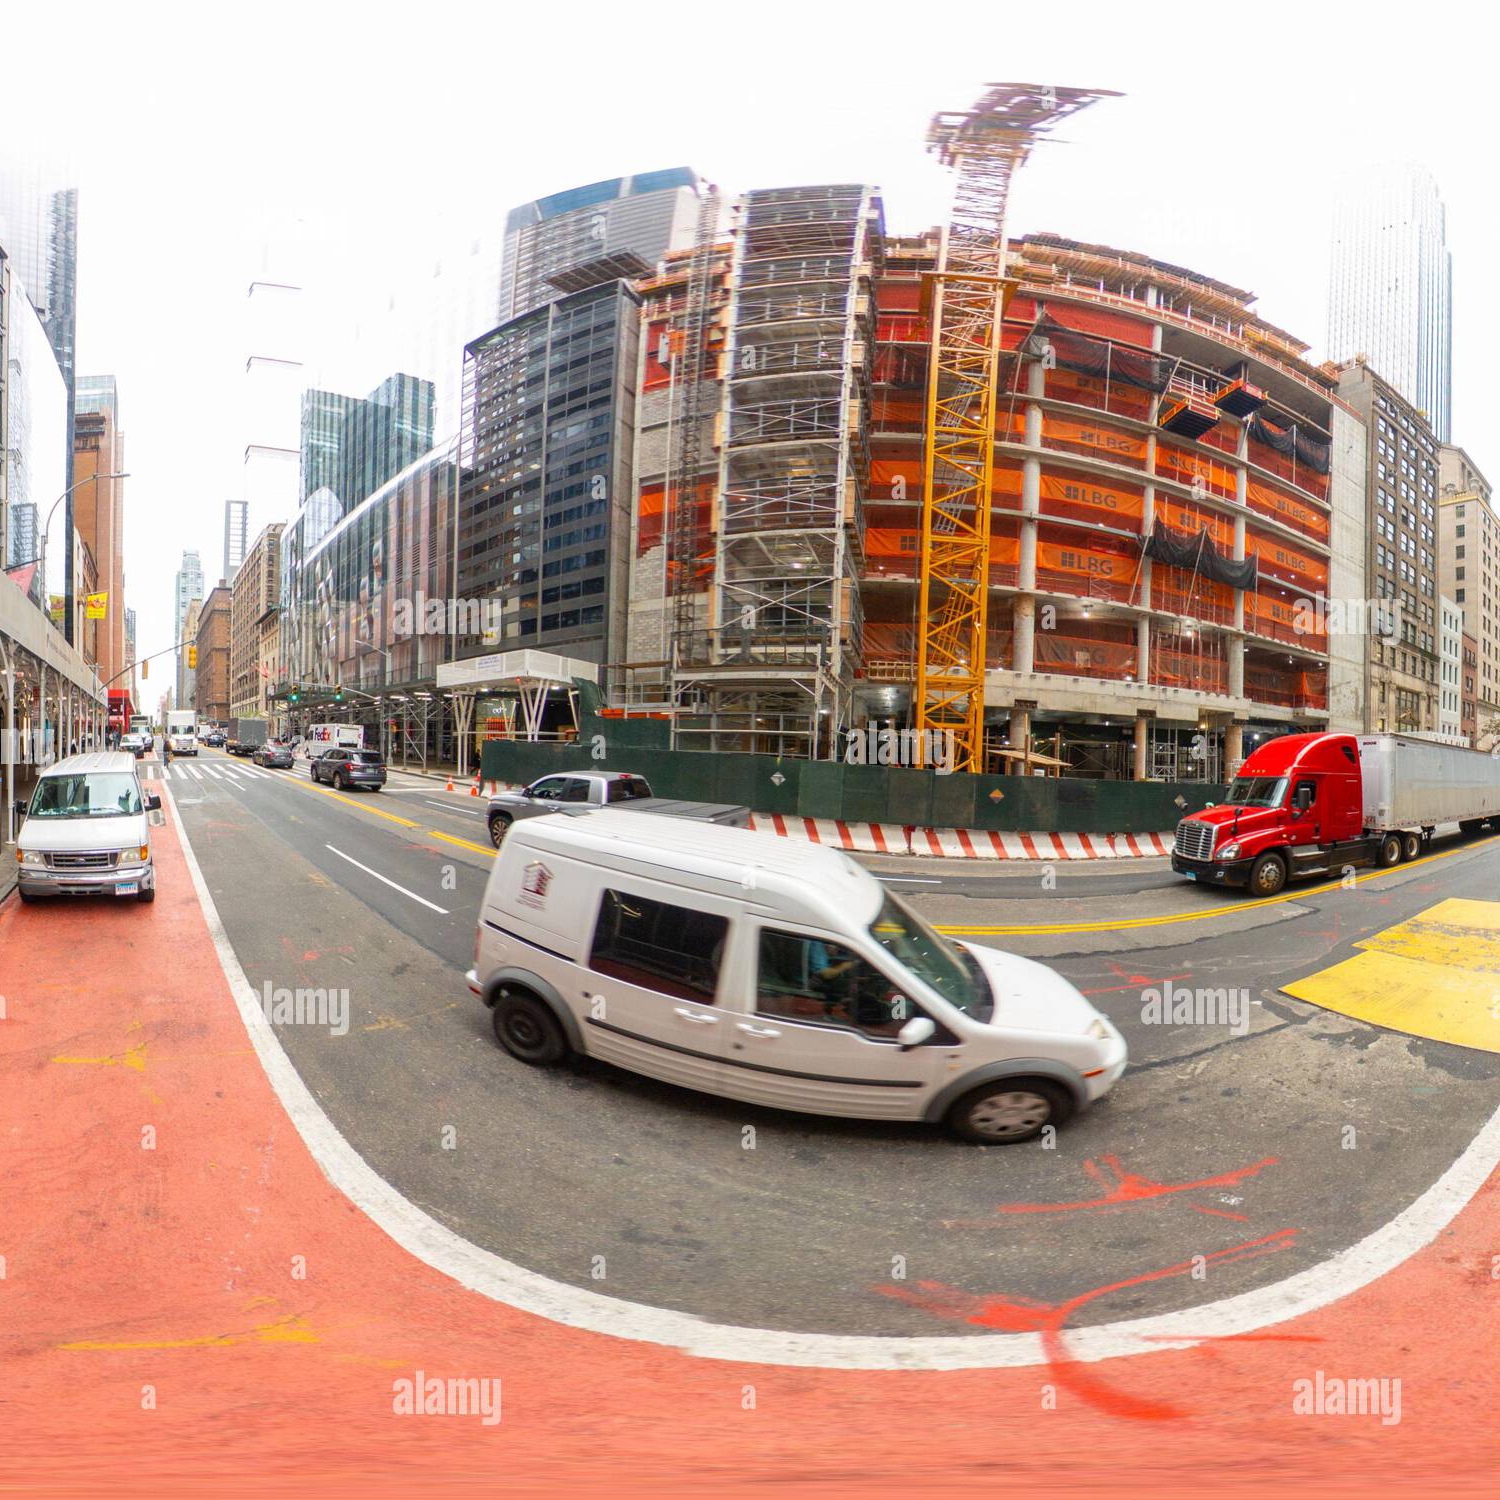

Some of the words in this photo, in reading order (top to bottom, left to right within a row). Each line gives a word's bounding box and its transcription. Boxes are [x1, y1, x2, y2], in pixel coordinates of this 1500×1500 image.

[1082, 488, 1117, 508] LBG
[1077, 554, 1113, 575] LBG
[1286, 553, 1306, 571] LBG
[315, 727, 332, 741] FedEx
